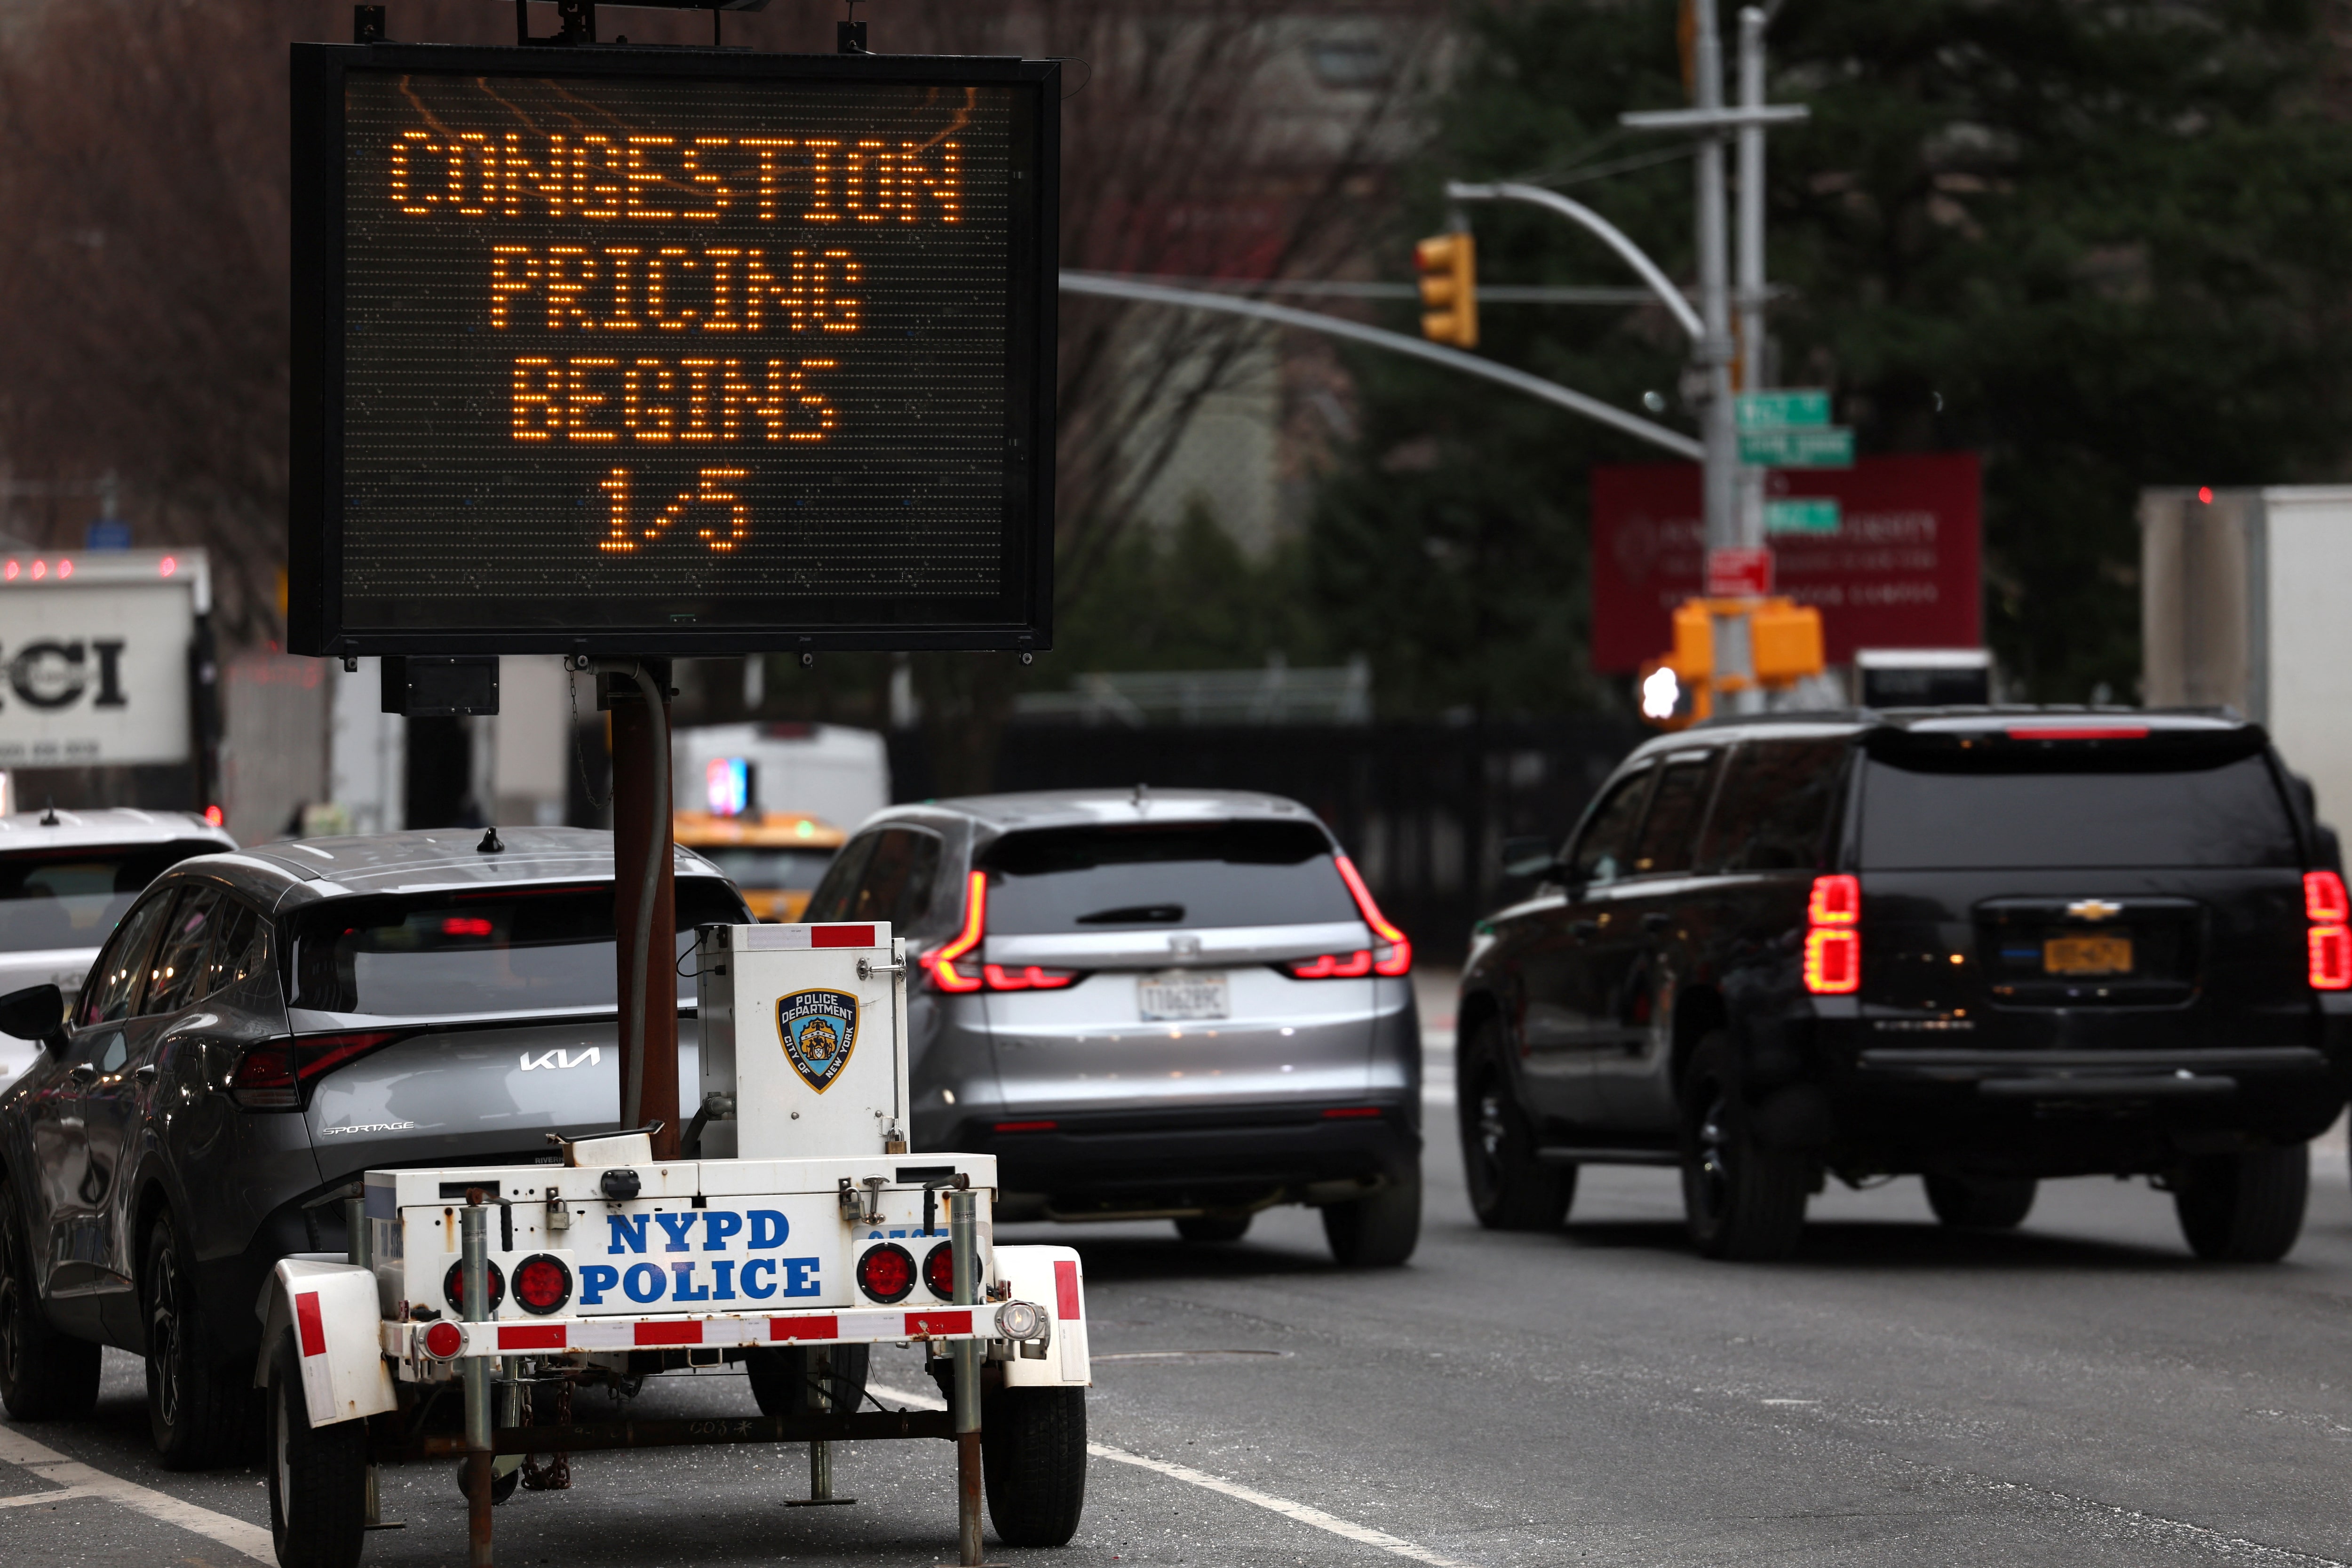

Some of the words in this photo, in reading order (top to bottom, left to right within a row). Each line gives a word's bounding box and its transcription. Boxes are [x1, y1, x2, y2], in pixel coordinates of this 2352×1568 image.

[391, 132, 960, 222] CONGESTION
[492, 246, 861, 331] PRICING
[513, 358, 837, 440] BEGINS
[601, 469, 745, 551] 1/5
[0, 637, 128, 710] CI
[782, 1004, 852, 1024] DEPARTMENT
[796, 994, 838, 1006] POLICE
[520, 1047, 601, 1071] KIA
[784, 1035, 800, 1059] CITY
[798, 1062, 810, 1074] OF
[825, 1057, 842, 1078] NEW
[840, 1027, 854, 1053] YORK
[323, 1122, 414, 1135] SPORTAGE
[607, 1210, 789, 1255] NYPD
[579, 1257, 821, 1305] POLICE
